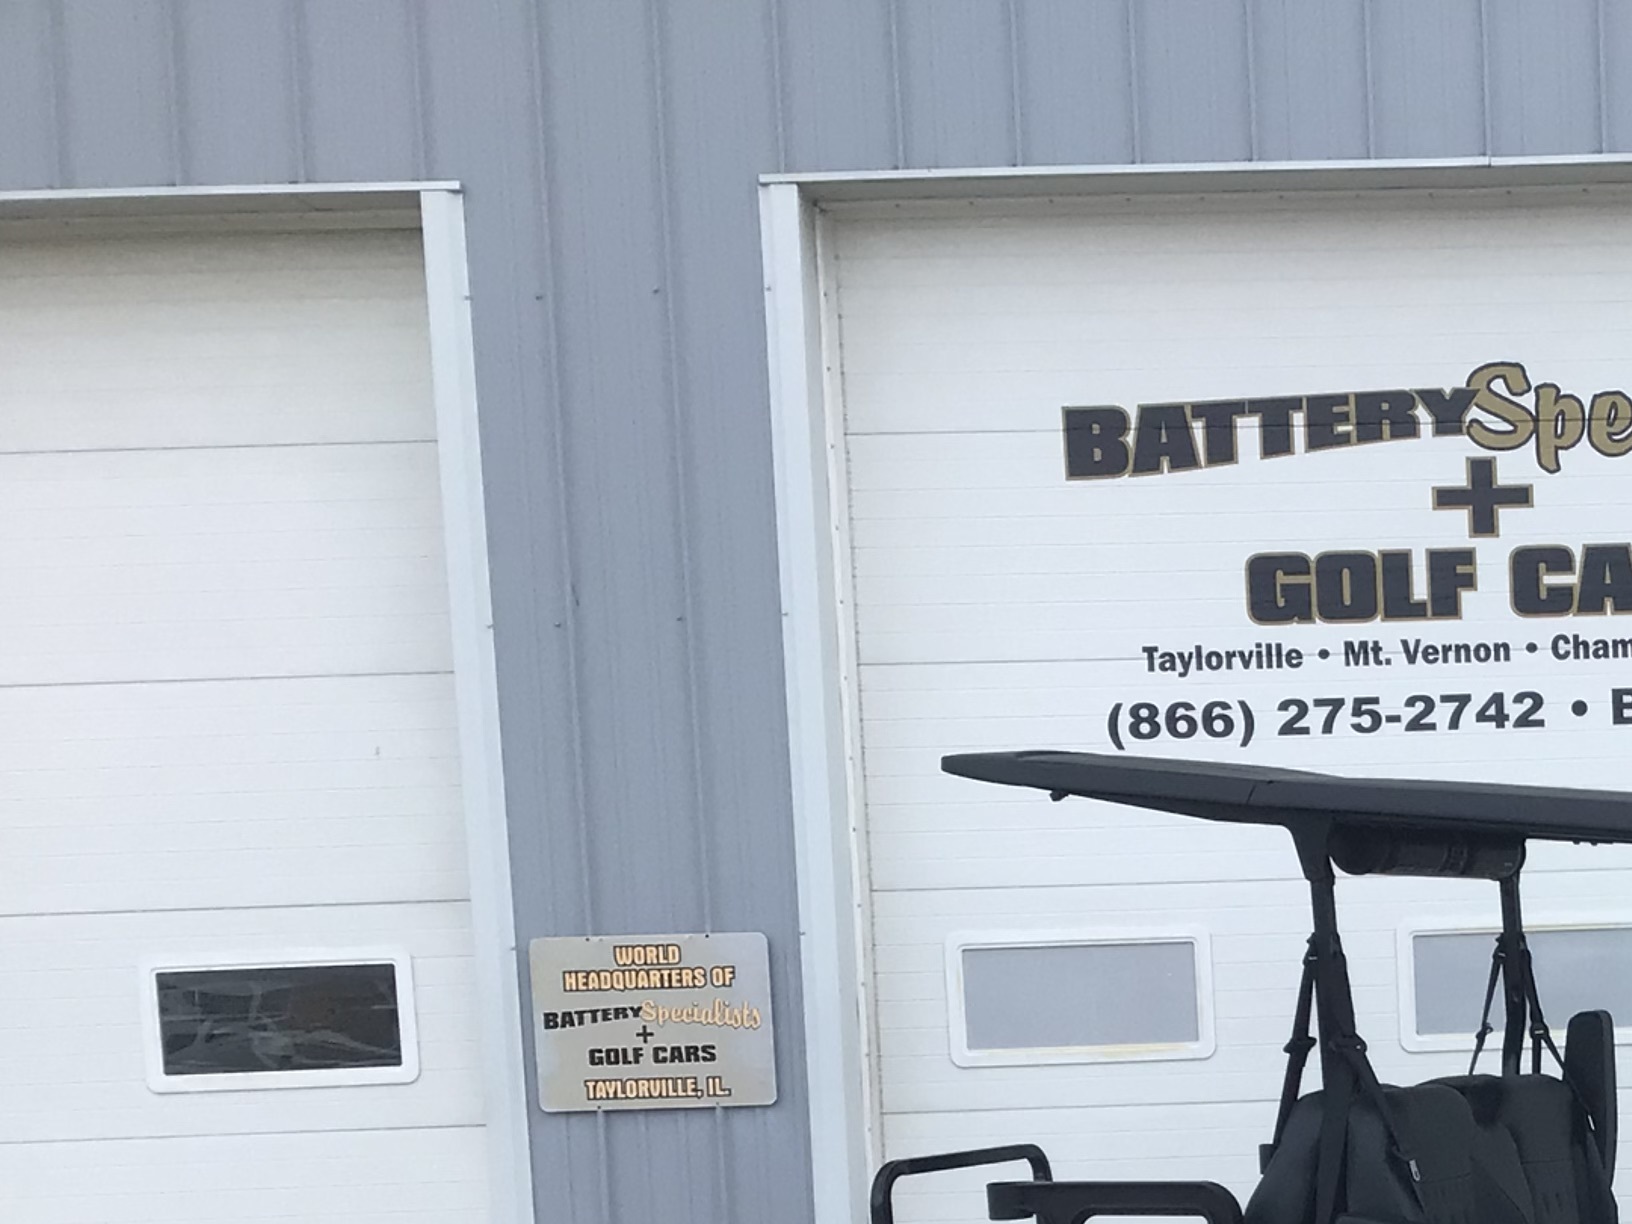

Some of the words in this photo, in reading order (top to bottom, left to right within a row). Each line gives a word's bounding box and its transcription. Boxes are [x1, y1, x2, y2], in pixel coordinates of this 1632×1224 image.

[1063, 387, 1480, 481] BATTERY
[1245, 547, 1478, 625] GOLF
[1142, 642, 1304, 677] Taylorville
[1343, 640, 1392, 667] Mt.
[1399, 638, 1511, 665] Vernon
[1107, 700, 1255, 751] (866)
[1277, 691, 1545, 737] 275-2742
[613, 944, 681, 966] WORLD
[563, 968, 707, 992] HEADQUARTERS
[710, 966, 735, 987] OF
[543, 1005, 643, 1030] BATTERY
[640, 998, 761, 1030] Specialists
[588, 1047, 644, 1066] GOLF
[652, 1044, 717, 1064] CARS
[584, 1077, 702, 1100] TAYLORVILLE,
